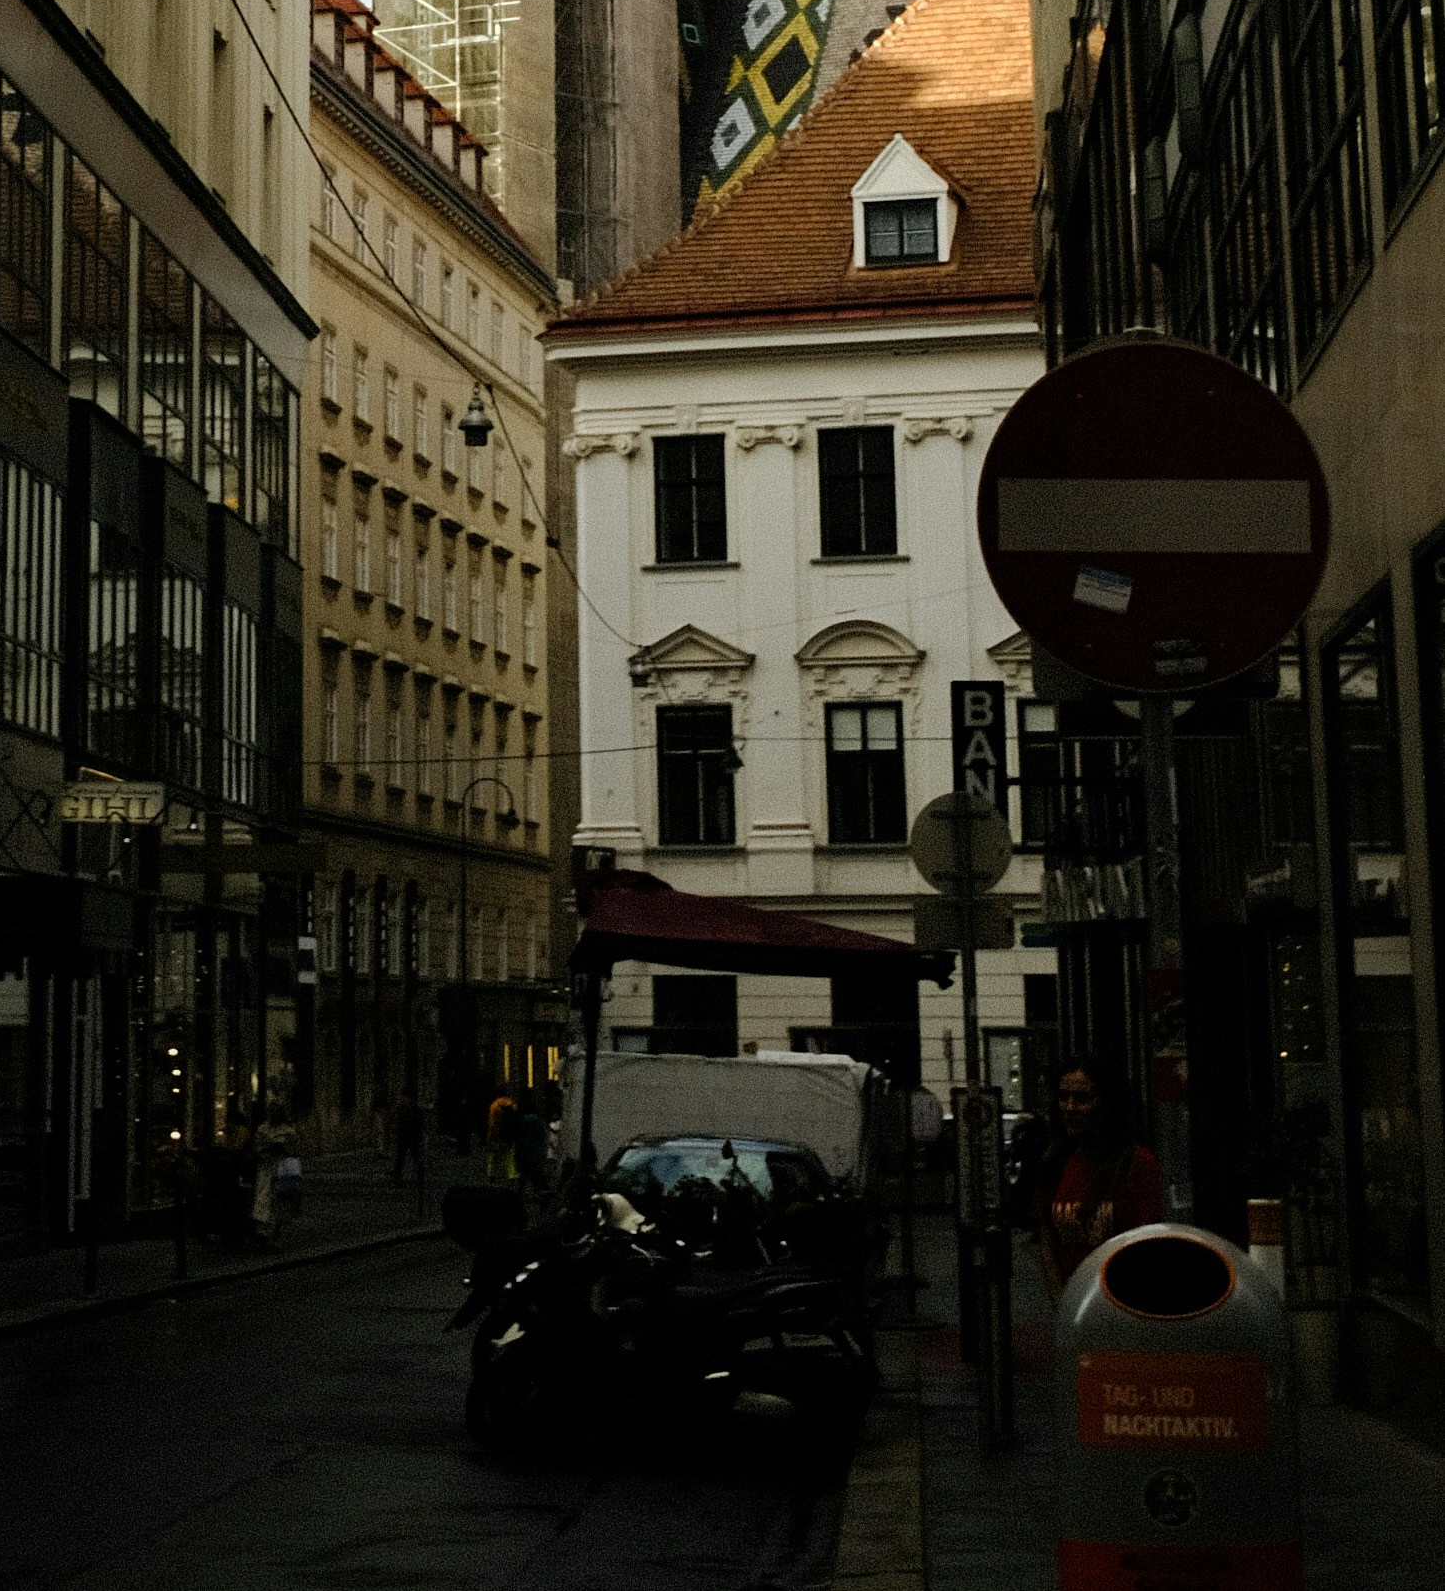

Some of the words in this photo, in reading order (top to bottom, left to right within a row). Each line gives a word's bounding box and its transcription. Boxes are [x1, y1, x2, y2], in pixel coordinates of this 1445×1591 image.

[1102, 1383, 1146, 1407] TAG-
[1152, 1385, 1196, 1409] UND
[1102, 1413, 1240, 1439] NACHTAKTIV.
